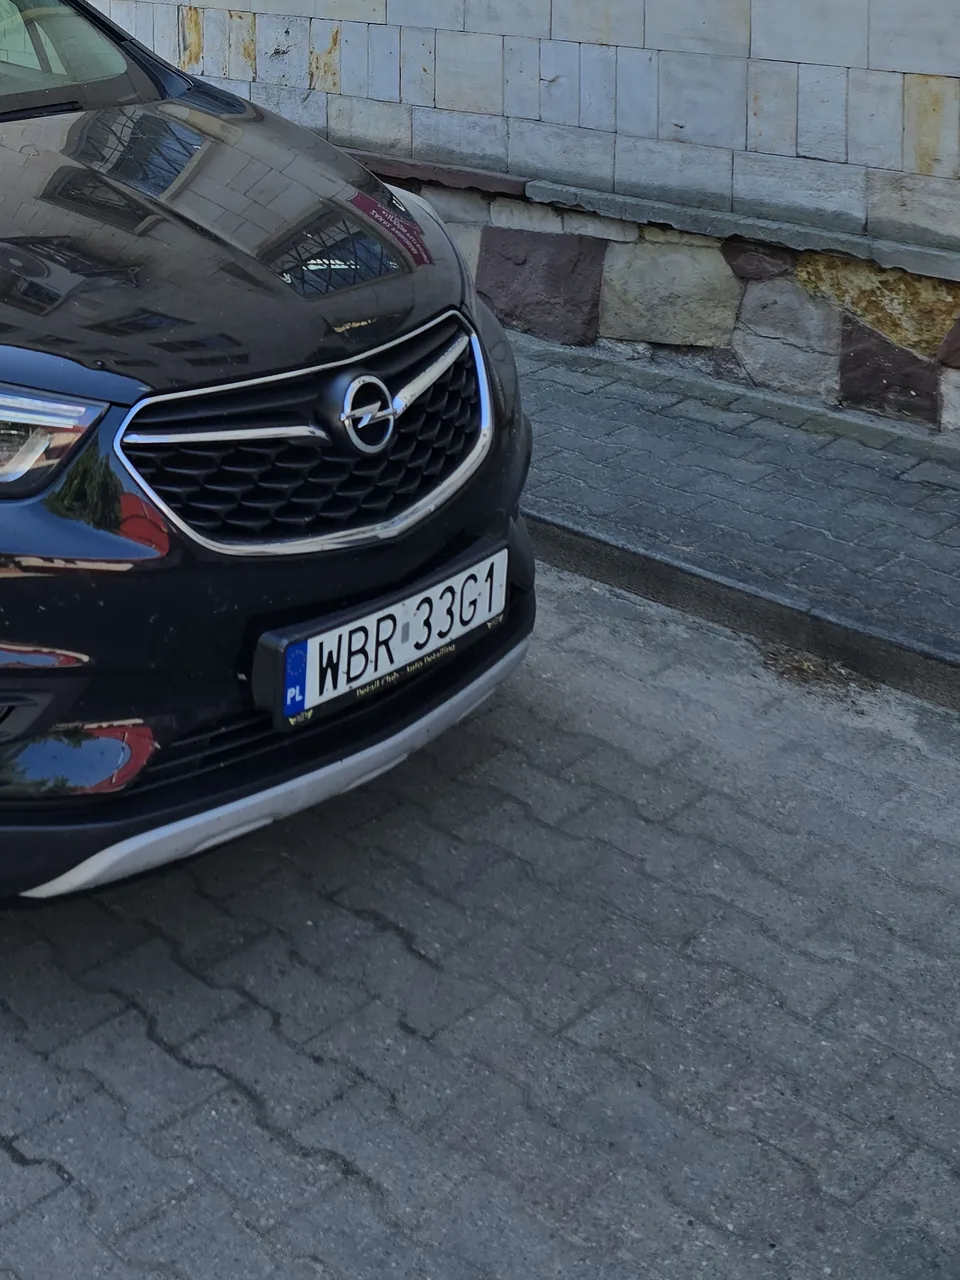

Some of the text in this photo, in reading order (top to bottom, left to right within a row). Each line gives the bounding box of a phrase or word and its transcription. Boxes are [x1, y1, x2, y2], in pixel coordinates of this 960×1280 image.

[318, 562, 495, 696] WBR 33G1
[286, 684, 303, 705] PL
